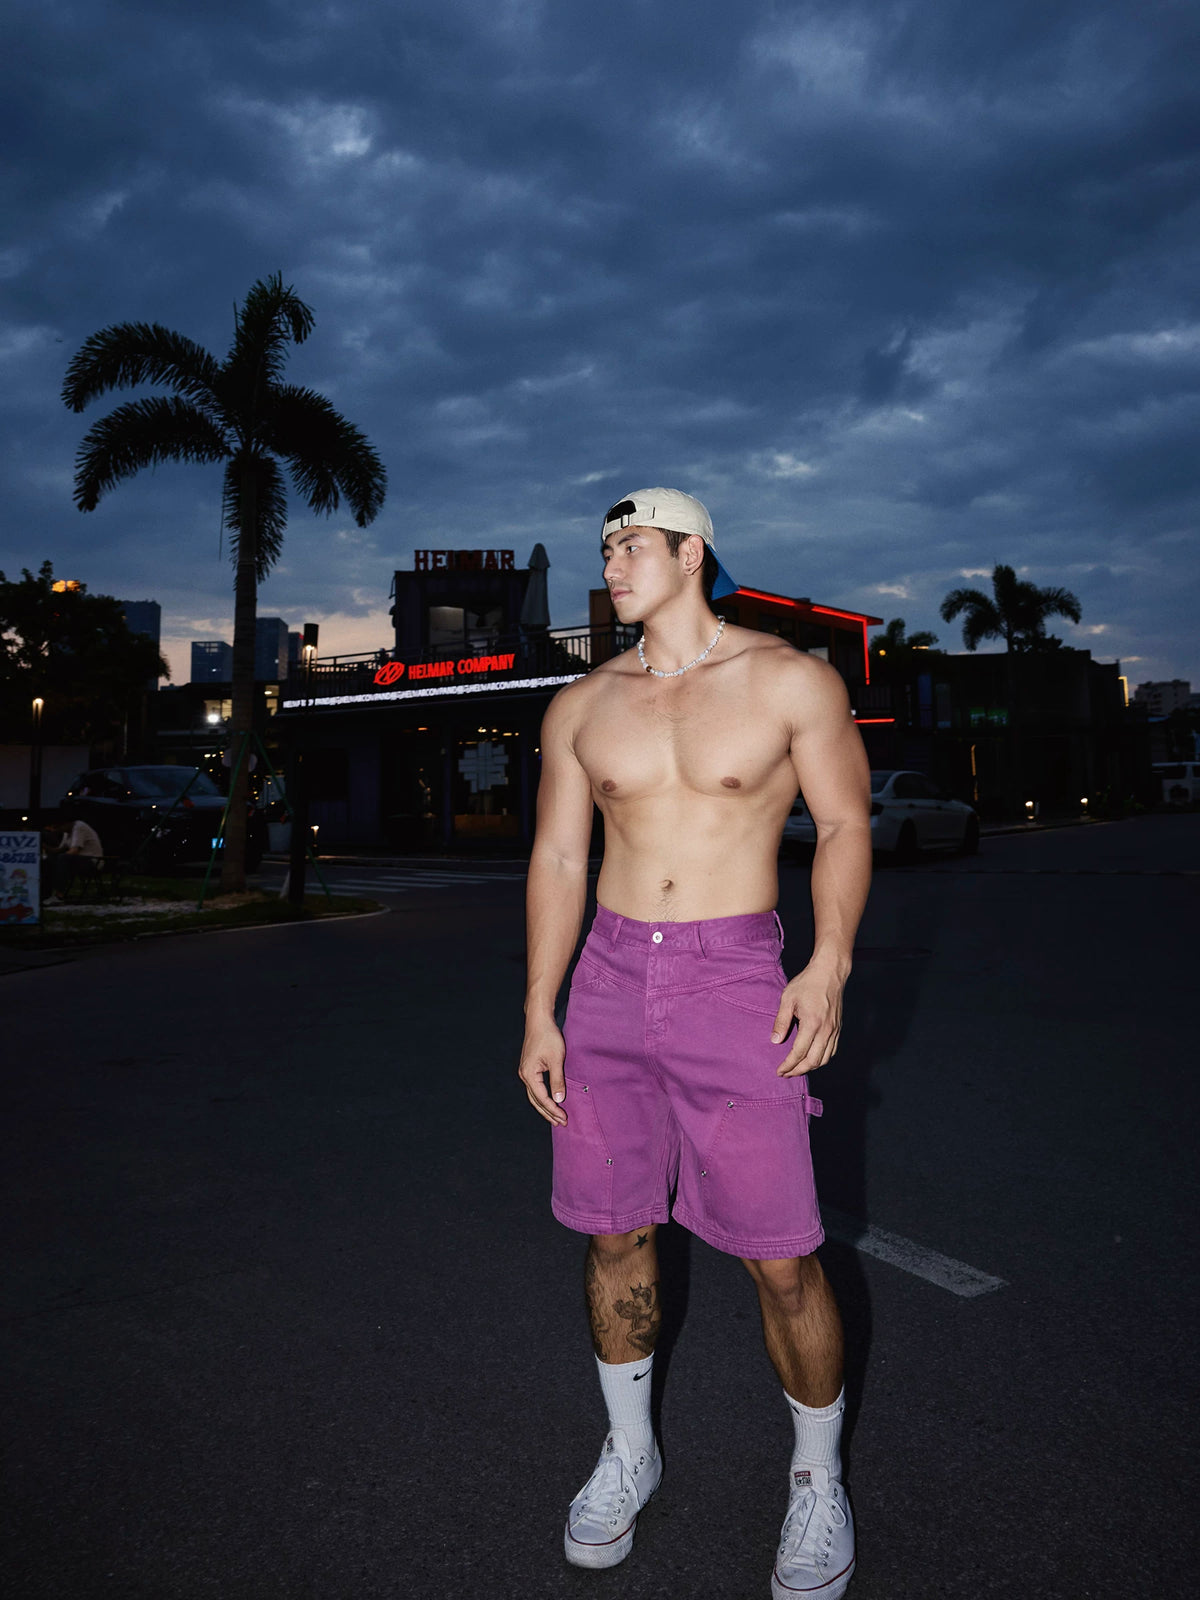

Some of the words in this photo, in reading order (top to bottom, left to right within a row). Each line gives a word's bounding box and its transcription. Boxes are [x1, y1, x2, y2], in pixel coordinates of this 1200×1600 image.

[414, 549, 514, 572] HELMAR
[408, 661, 455, 680] HELMAR
[457, 653, 515, 675] COMPANY
